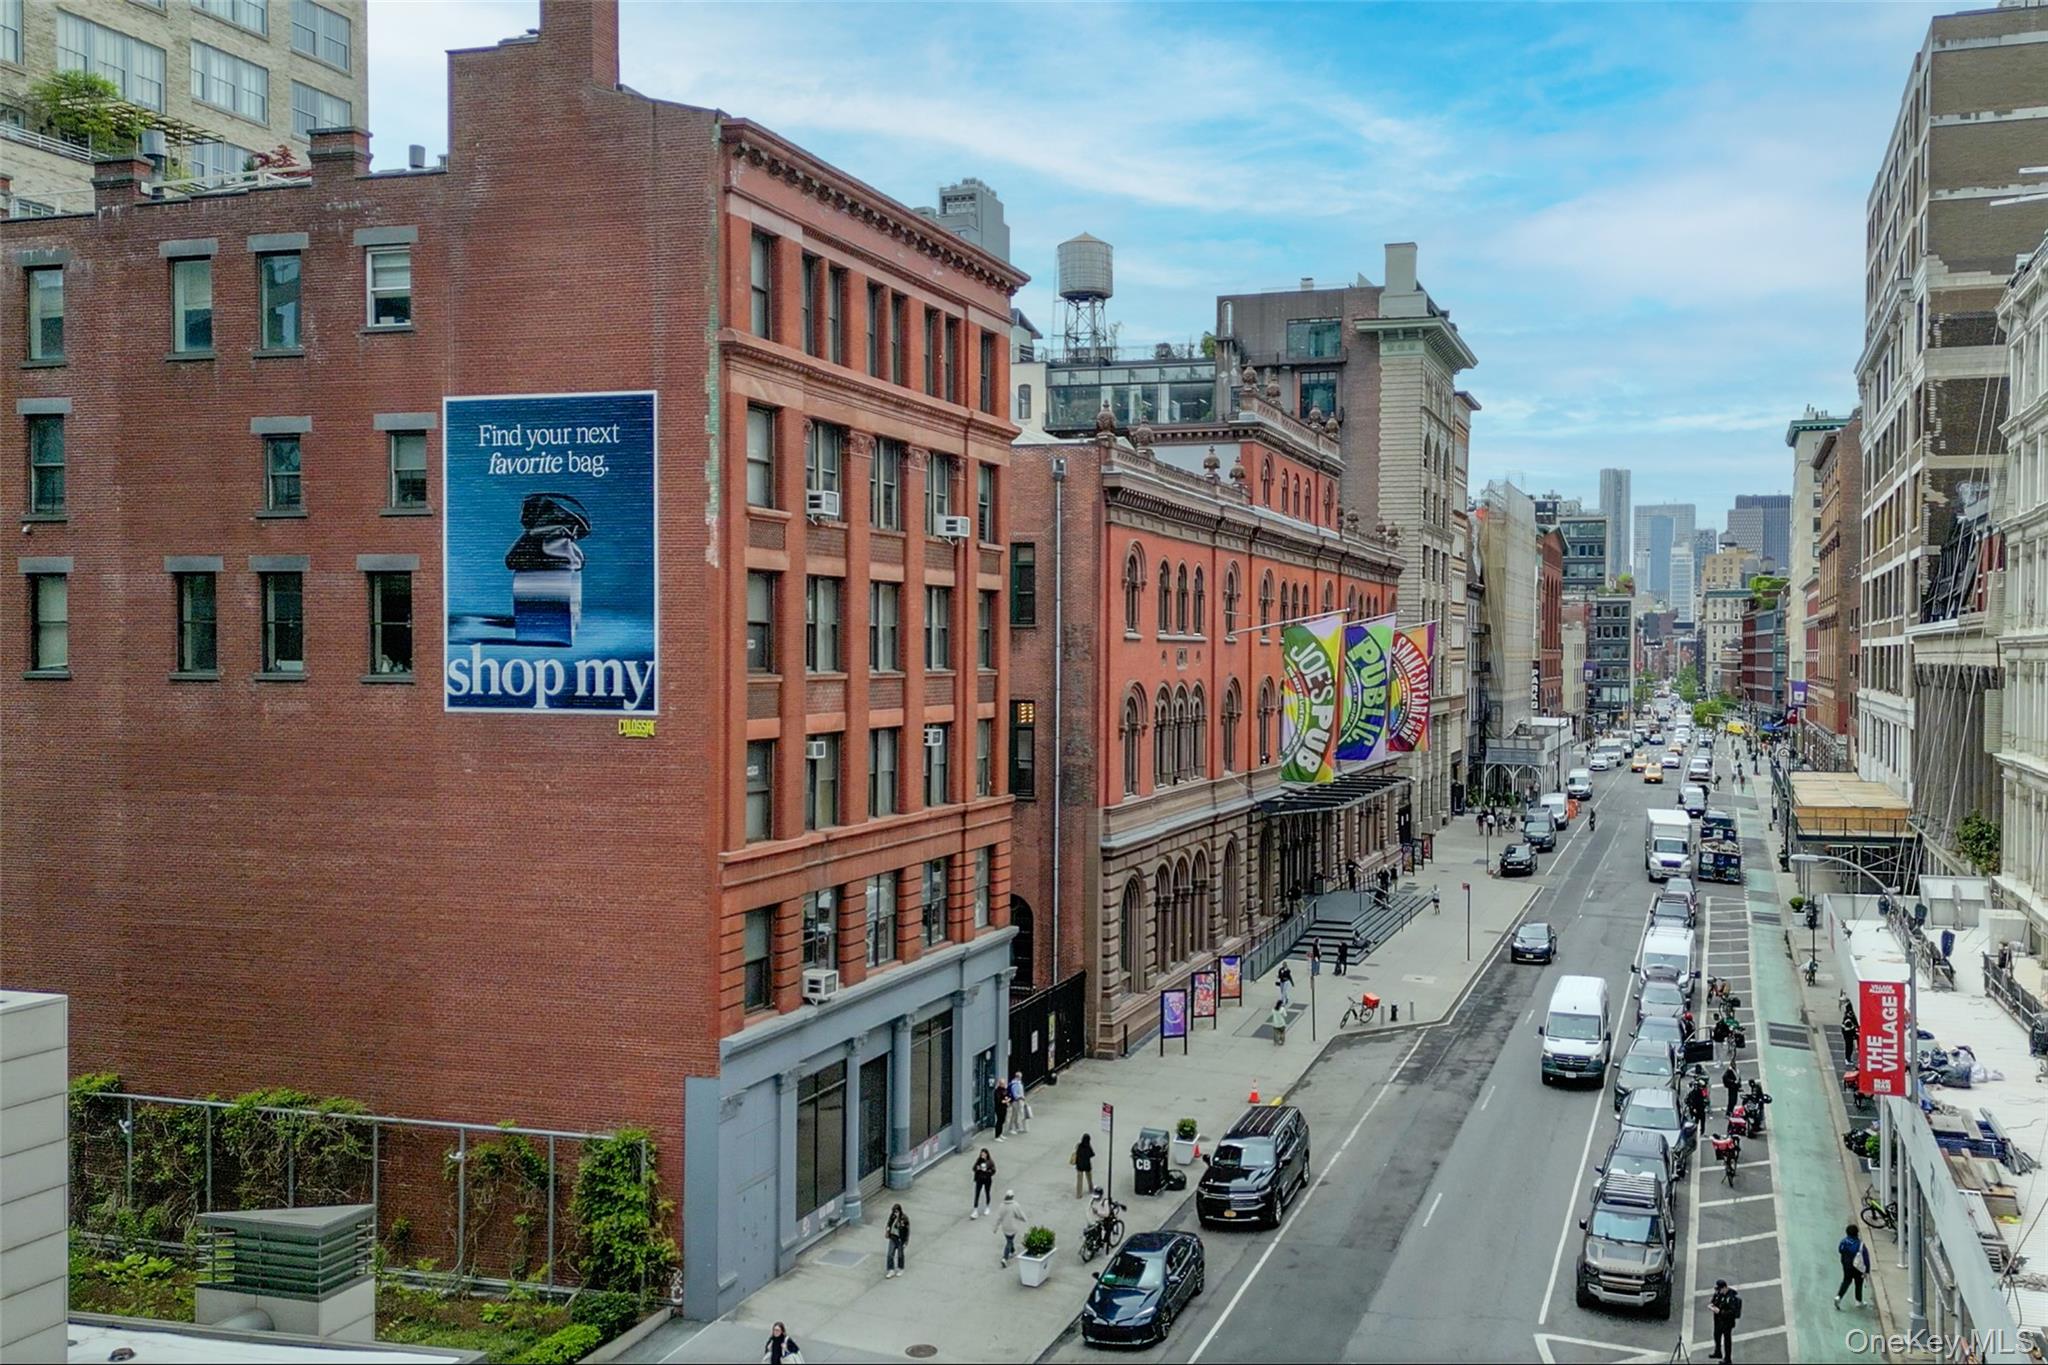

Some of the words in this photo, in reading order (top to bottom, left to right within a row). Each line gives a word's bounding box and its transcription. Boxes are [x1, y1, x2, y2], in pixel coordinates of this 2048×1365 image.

[478, 424, 522, 447] Find
[525, 426, 571, 451] your
[576, 423, 621, 445] next
[487, 451, 564, 475] favorite
[568, 450, 610, 478] bag.
[447, 642, 566, 709] shop
[574, 658, 656, 711] my
[1290, 641, 1334, 704] JOE'S
[1392, 636, 1430, 722] SHAKESPEARE
[1295, 705, 1335, 773] PUB
[1398, 718, 1415, 741] PARK
[1866, 1036, 1882, 1072] THE
[1882, 996, 1898, 1073] VILLAGE
[1135, 1158, 1151, 1171] CB
